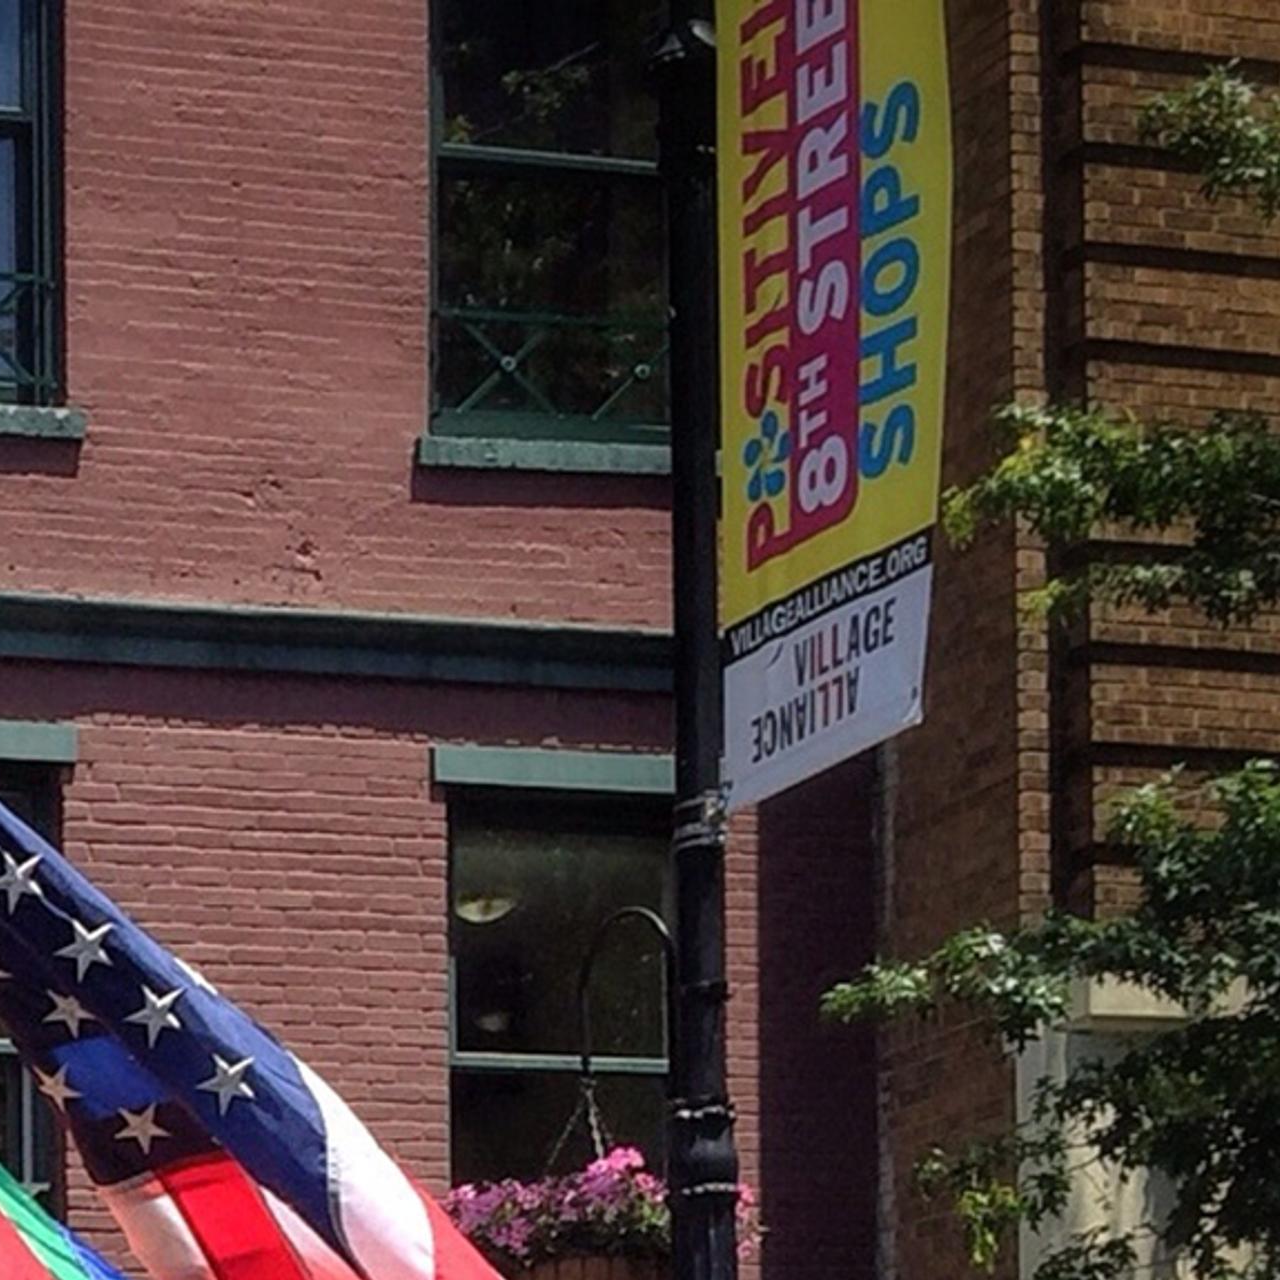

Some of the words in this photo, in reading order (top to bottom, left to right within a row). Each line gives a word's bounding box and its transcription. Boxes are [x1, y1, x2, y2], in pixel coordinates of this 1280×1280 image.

[858, 80, 920, 480] SHOPS
[797, 354, 848, 513] 8TH
[730, 535, 928, 656] VILLAGEALLIANCE.ORG
[793, 596, 897, 687] VILLAGE
[750, 664, 861, 764] ALLIANCE
